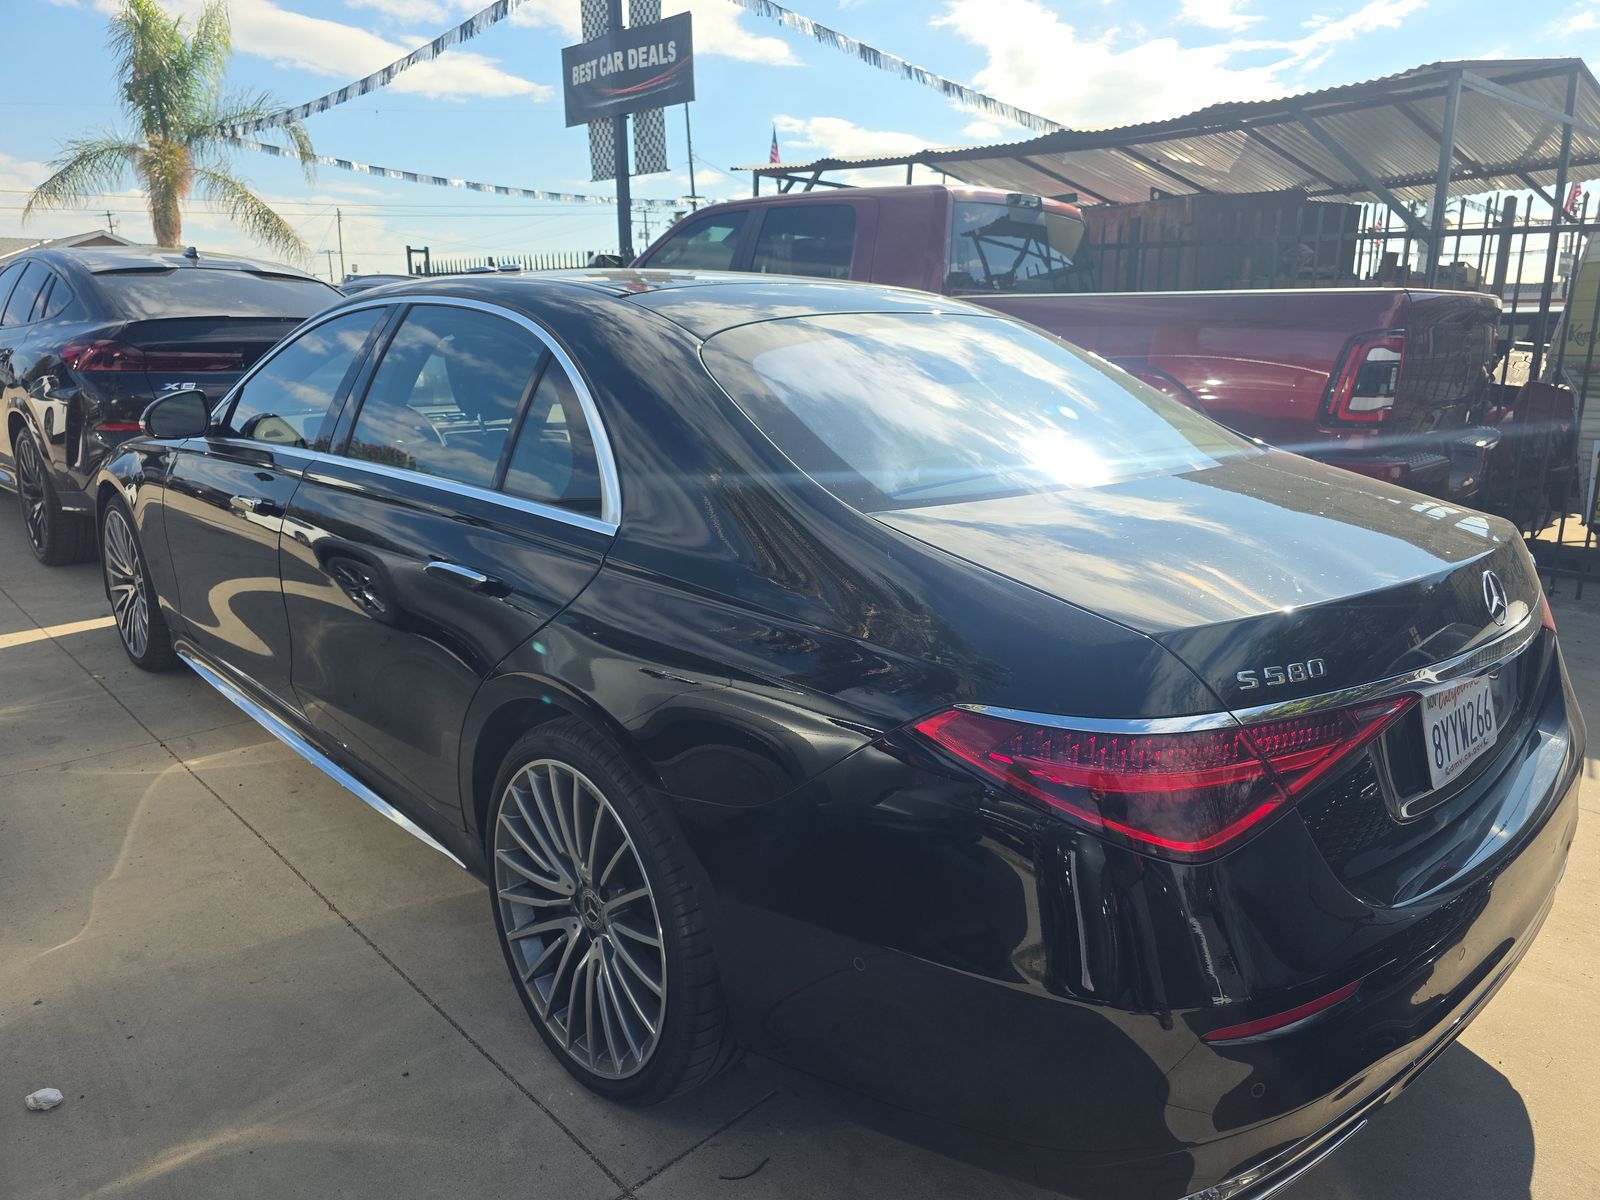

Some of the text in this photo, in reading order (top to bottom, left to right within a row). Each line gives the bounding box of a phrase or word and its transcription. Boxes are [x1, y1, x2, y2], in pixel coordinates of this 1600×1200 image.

[572, 40, 677, 86] BEST CAR DEALS
[1236, 658, 1327, 690] S 580
[1432, 688, 1492, 769] 8YYW266
